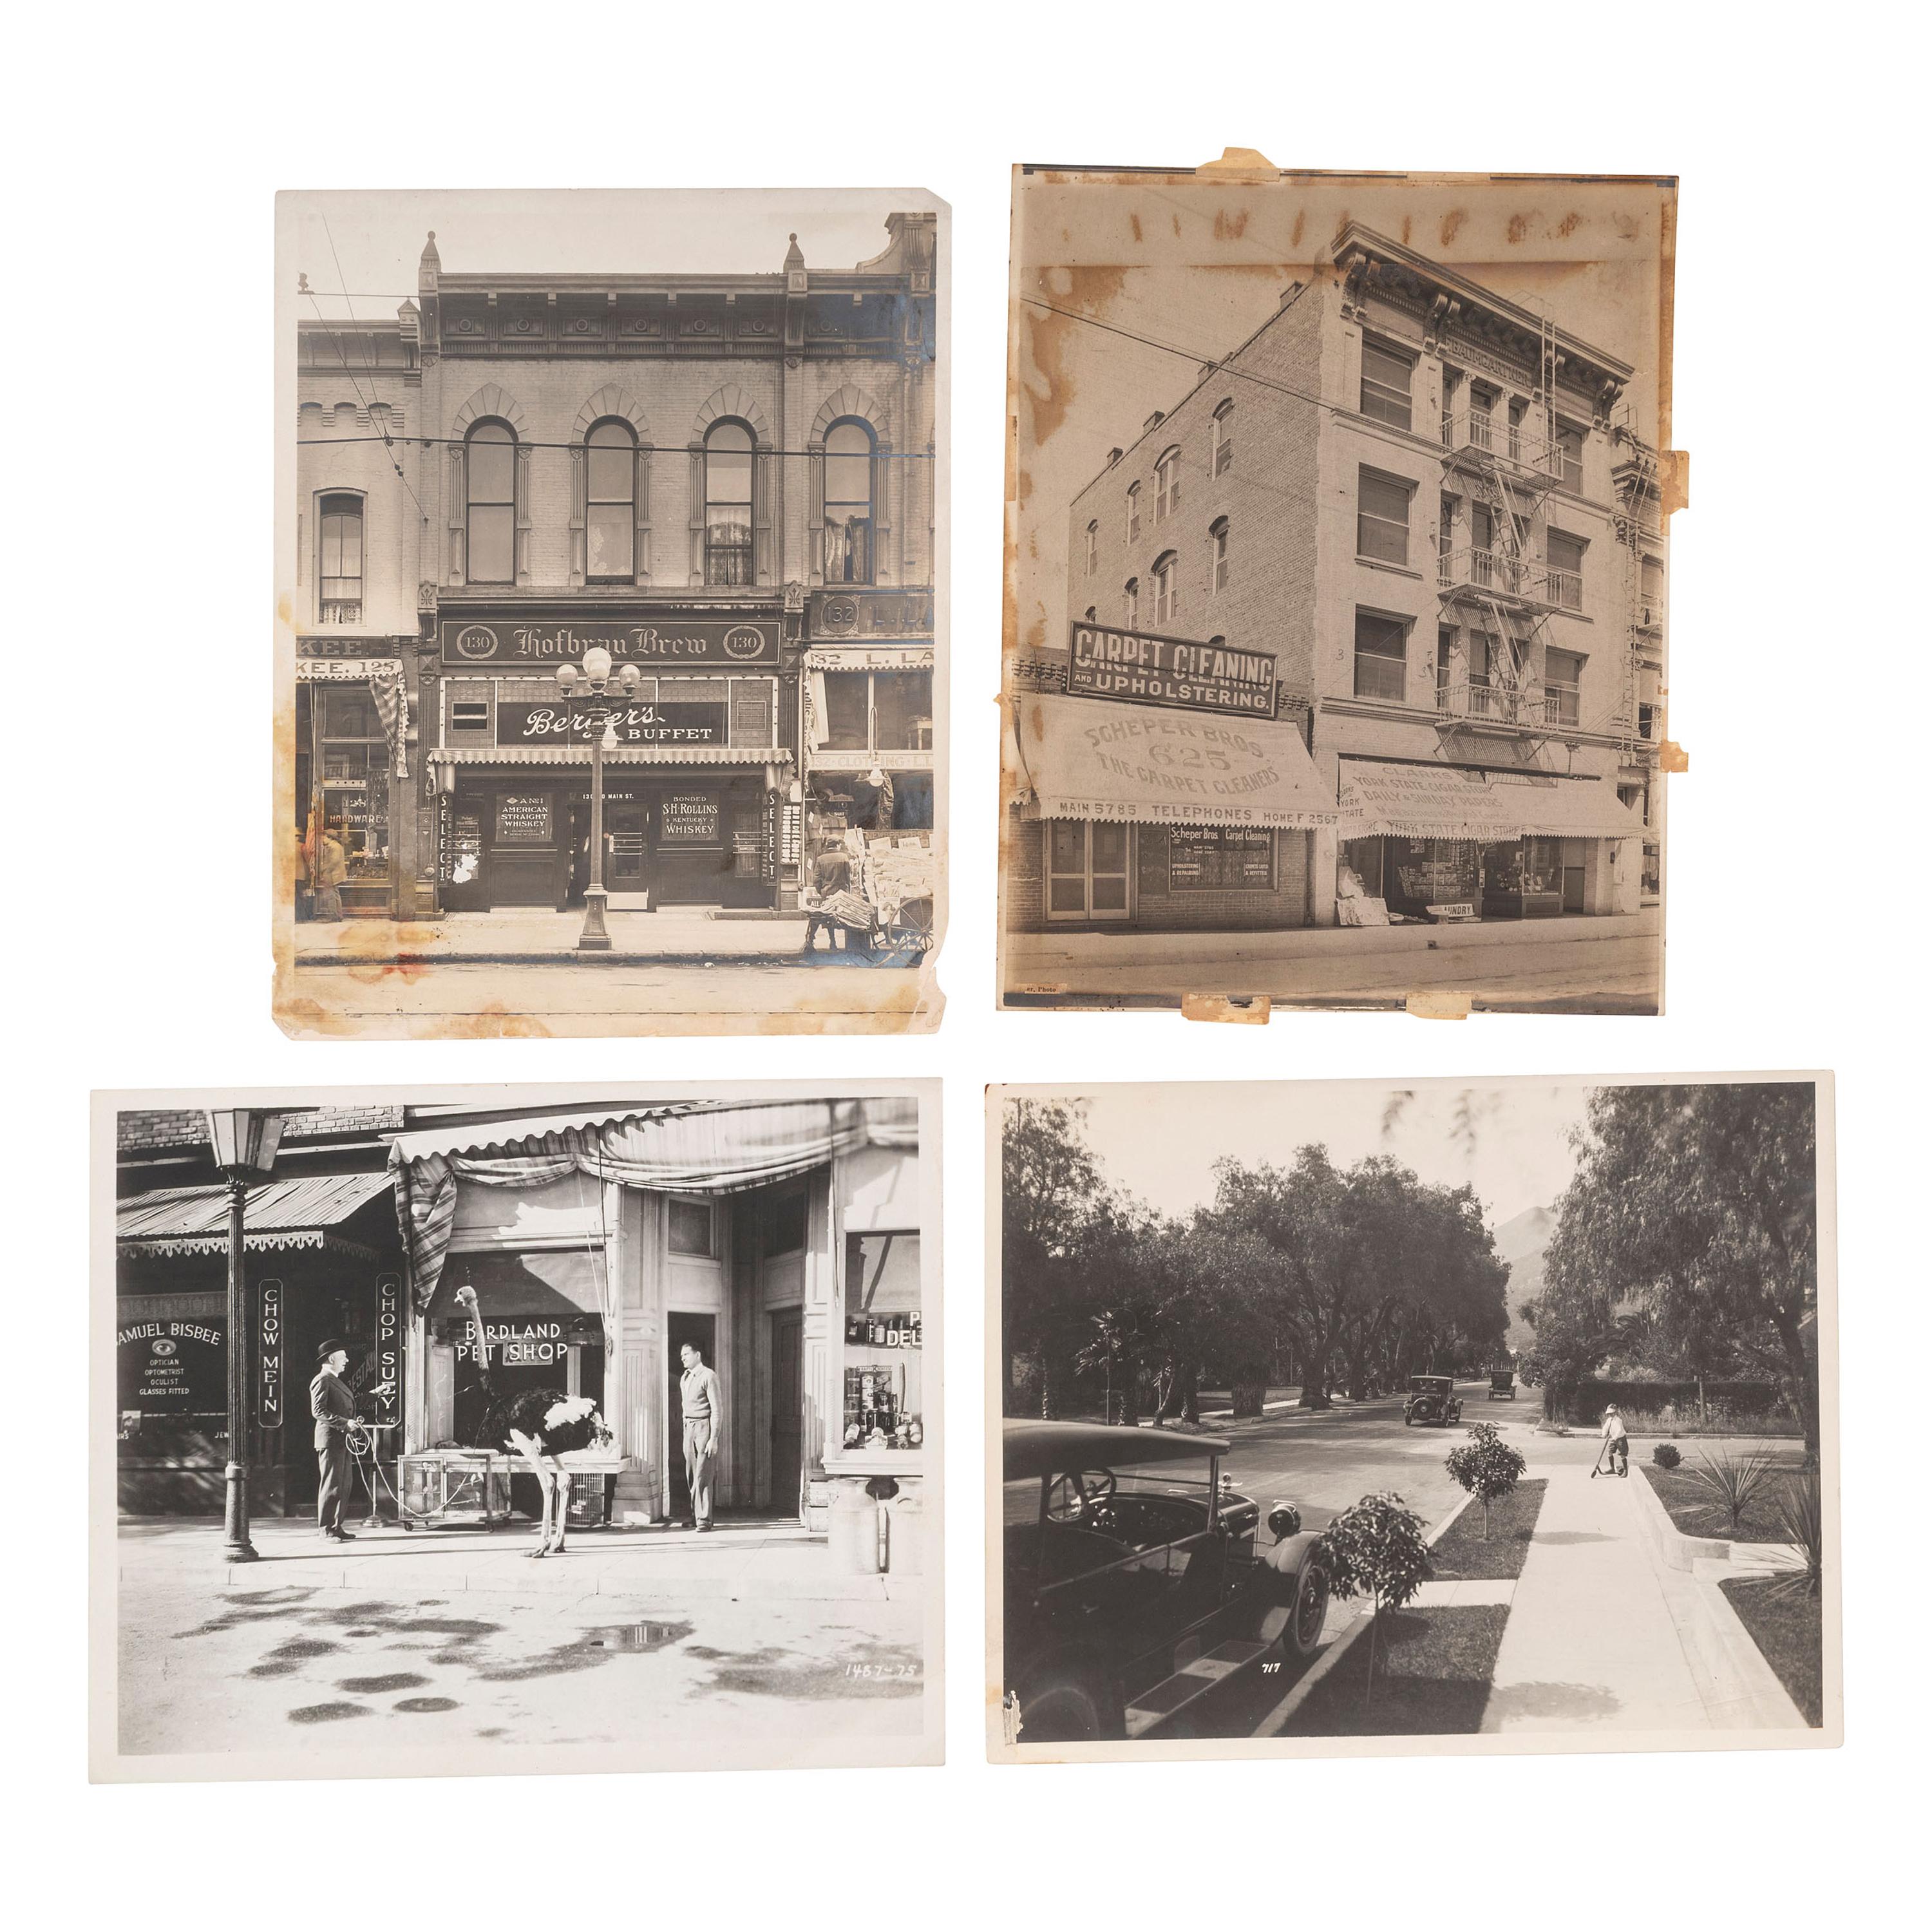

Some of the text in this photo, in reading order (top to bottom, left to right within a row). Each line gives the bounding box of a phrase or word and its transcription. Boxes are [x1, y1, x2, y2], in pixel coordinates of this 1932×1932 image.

[827, 606, 854, 623] 132
[464, 637, 490, 648] 130
[629, 627, 707, 658] Brew
[732, 637, 757, 648] 130
[296, 663, 349, 673] KEE.
[1075, 630, 1272, 692] CARPET CLEANING
[1075, 673, 1269, 709] AND UPHOLSTERING.
[523, 706, 665, 738] Berer's
[629, 728, 712, 739] BUFFET
[1084, 720, 1196, 748] SCHEPER
[1149, 743, 1231, 771] 625
[1095, 752, 1280, 795] THE CARPET CLEANERS
[1352, 777, 1388, 787] YORK
[1390, 779, 1427, 791] STATE
[1428, 782, 1462, 793] CIGAR
[1341, 798, 1359, 807] YORK
[1362, 790, 1401, 802] DAILY
[1410, 794, 1455, 806] SUNDAY
[330, 815, 381, 823] HARDWARE
[1060, 802, 1338, 825] MAIN 5785 TELEPHONES HOME F 2567
[1343, 808, 1364, 818] TATE
[667, 823, 714, 834] WHISKEY
[1171, 827, 1202, 841] Scheper
[1226, 828, 1271, 844] Carpet Cleaning
[1422, 824, 1457, 835] STATE
[1461, 824, 1490, 835] CIGAR
[1493, 826, 1519, 836] STORE
[263, 1289, 279, 1345] CHOW
[381, 1283, 395, 1341] CHOP
[910, 1311, 920, 1326] P
[117, 1323, 222, 1347] AMUEL BISBEE
[466, 1321, 561, 1340] BRDLAND
[887, 1330, 922, 1345] DEL
[509, 1343, 567, 1360] SHOP
[263, 1356, 278, 1412] MEIN
